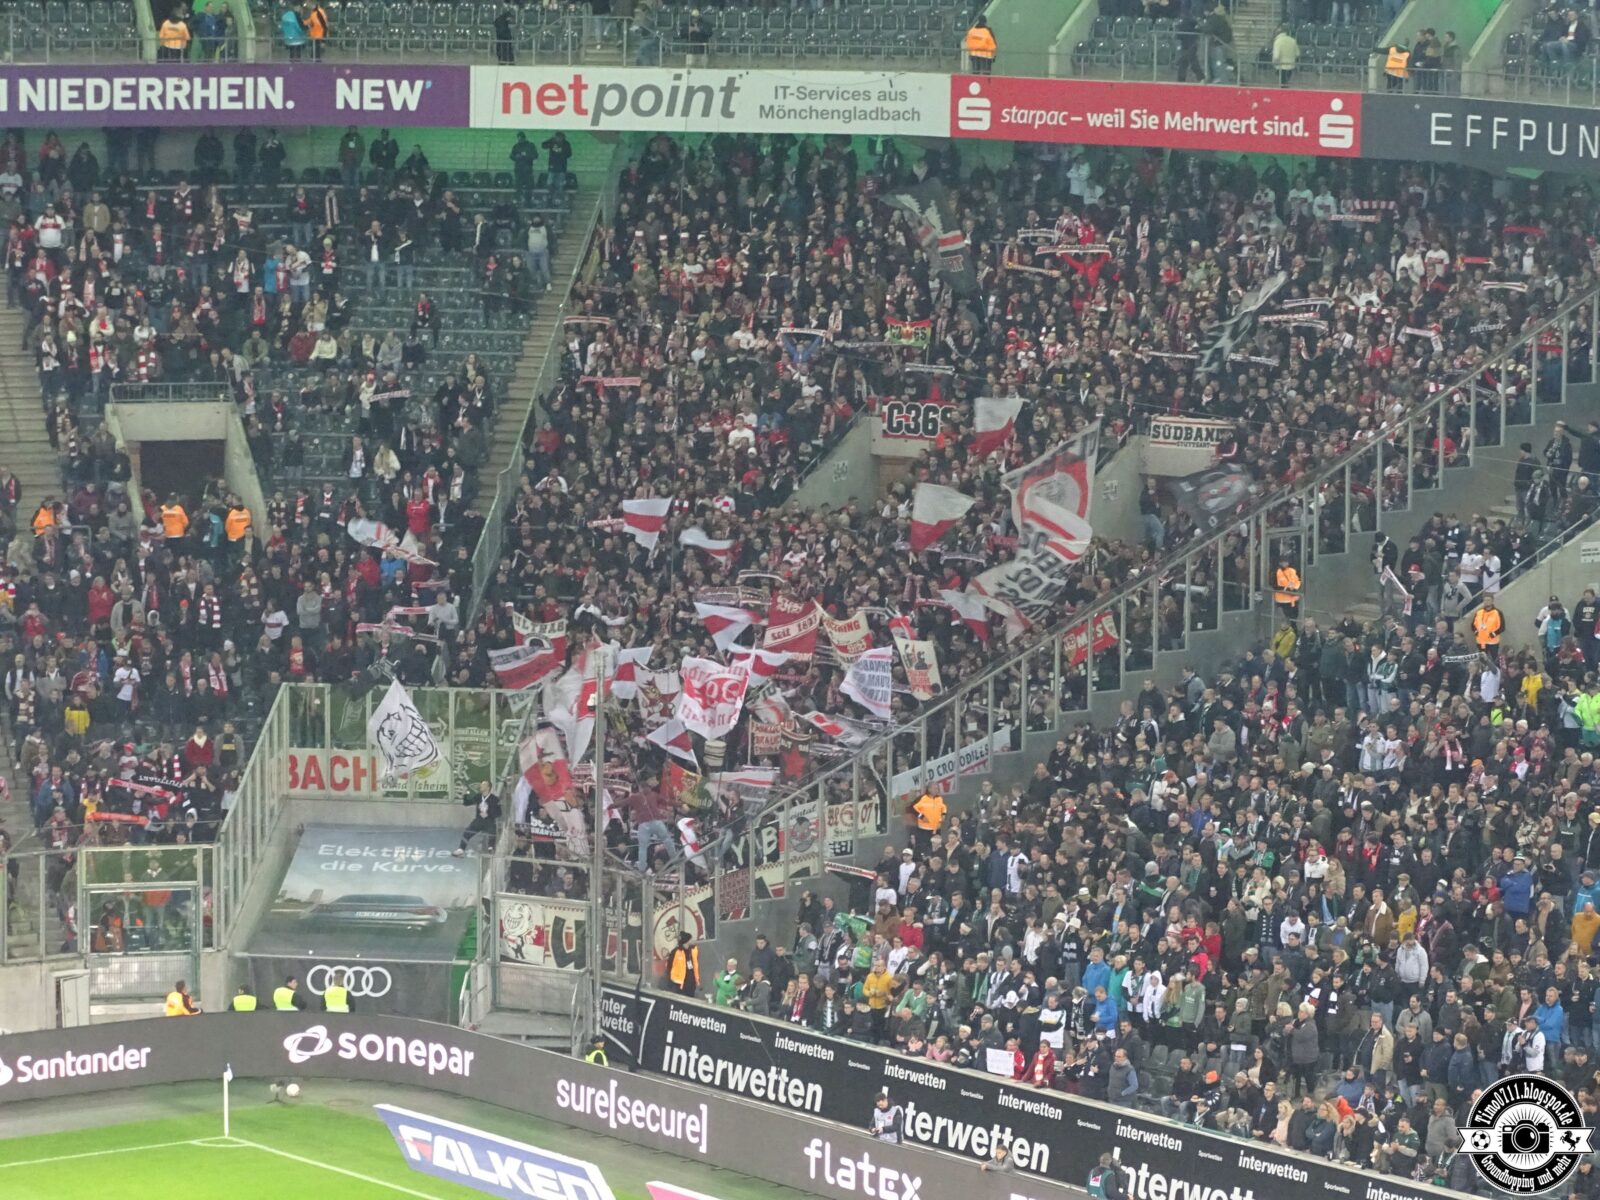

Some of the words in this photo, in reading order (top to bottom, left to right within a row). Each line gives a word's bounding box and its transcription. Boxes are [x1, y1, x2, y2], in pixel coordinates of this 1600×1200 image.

[19, 76, 295, 112] NIEDERRHEIN.
[502, 73, 740, 126] netpoint
[774, 84, 871, 102] IT-Services
[877, 87, 908, 102] aus
[759, 103, 921, 123] Mönchengladbach
[1001, 106, 1067, 126] starpac
[1087, 108, 1124, 129] weil
[1130, 109, 1159, 130] Sie
[1164, 111, 1257, 135] Mehrwert
[1263, 116, 1310, 137] sind.
[318, 844, 477, 858] Elektrisiet
[320, 860, 363, 872] die
[372, 861, 461, 873] Kurve.
[602, 998, 627, 1016] nter
[669, 1004, 727, 1034] interwetten
[338, 1031, 474, 1077] sonepar
[775, 1032, 834, 1061] interwetten
[17, 1045, 151, 1083] Santander
[662, 1030, 824, 1113] interwetten
[884, 1059, 946, 1090] interwetten
[998, 1089, 1063, 1121] interwetten
[1116, 1119, 1182, 1152] interwetten
[1238, 1150, 1308, 1183] interwetten
